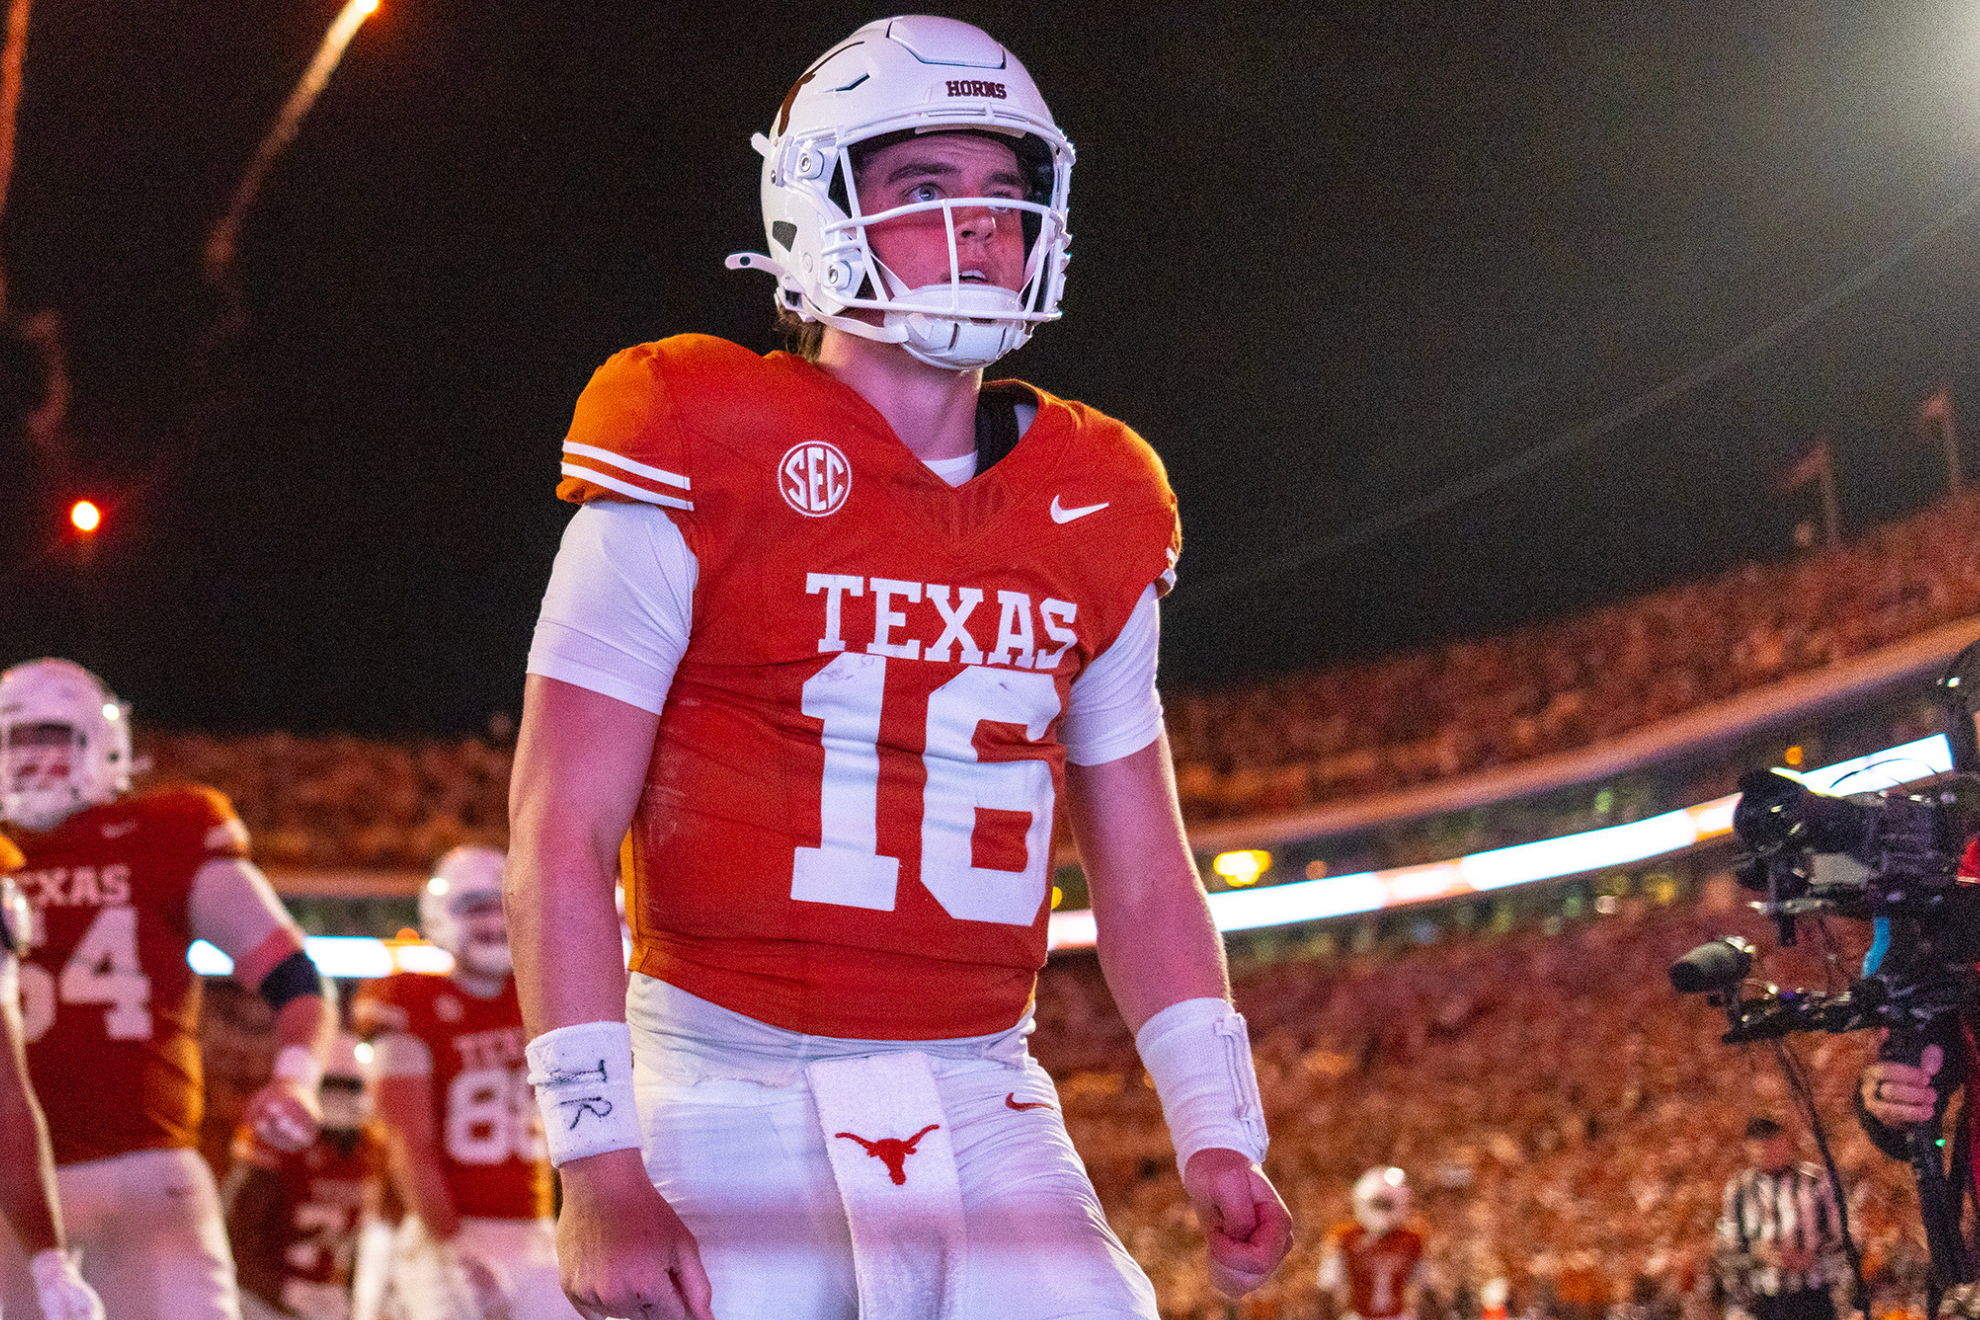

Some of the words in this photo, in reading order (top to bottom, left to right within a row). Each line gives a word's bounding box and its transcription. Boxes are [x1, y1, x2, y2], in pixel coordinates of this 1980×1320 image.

[945, 80, 1007, 99] HORNS
[784, 446, 845, 511] SEC
[805, 572, 1078, 669] TEXAS
[790, 651, 1062, 927] 16
[16, 864, 131, 906] XAS
